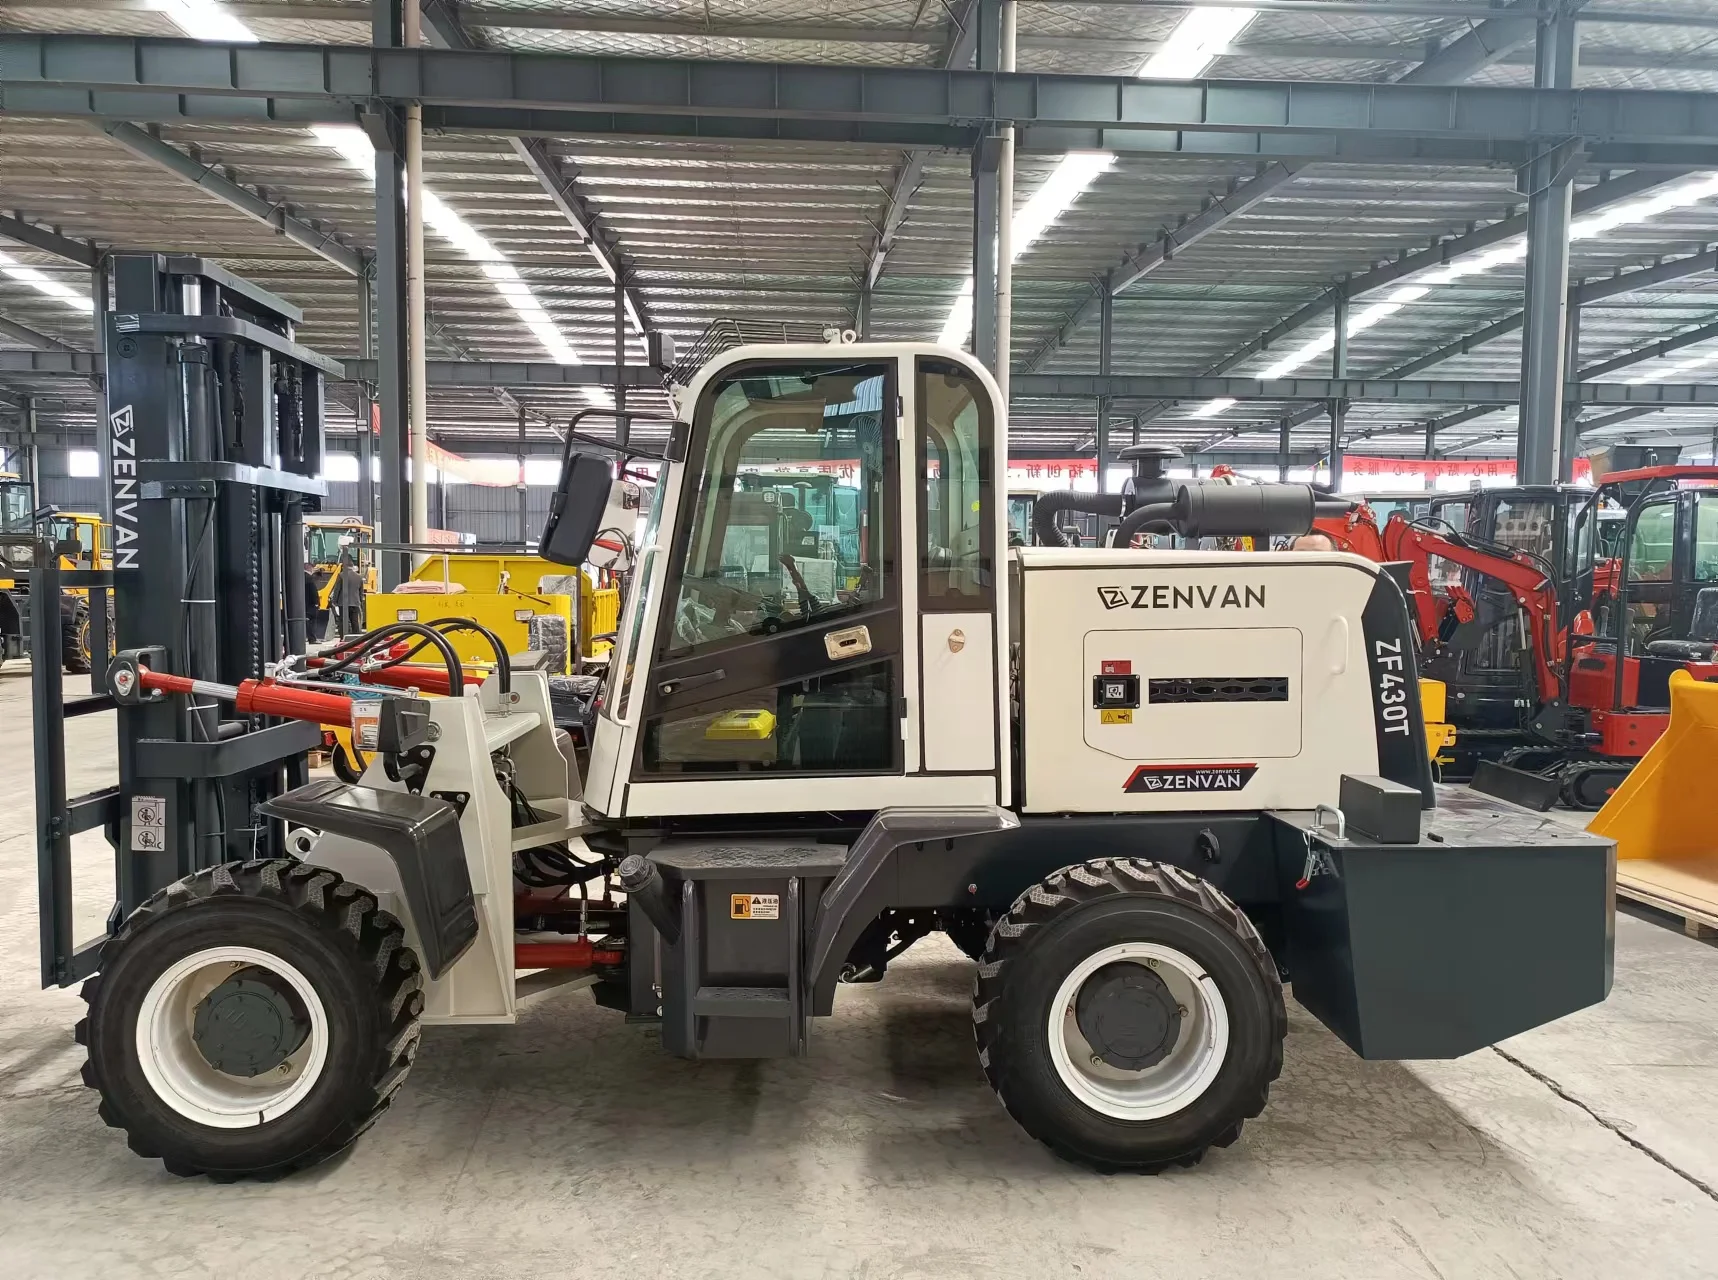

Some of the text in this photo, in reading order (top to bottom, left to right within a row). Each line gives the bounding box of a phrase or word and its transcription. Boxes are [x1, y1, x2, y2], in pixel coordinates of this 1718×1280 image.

[113, 438, 139, 569] ZENVAN
[1131, 585, 1265, 609] ZENVAN
[1375, 638, 1410, 736] ZF430T
[1163, 774, 1240, 789] ZENVAN
